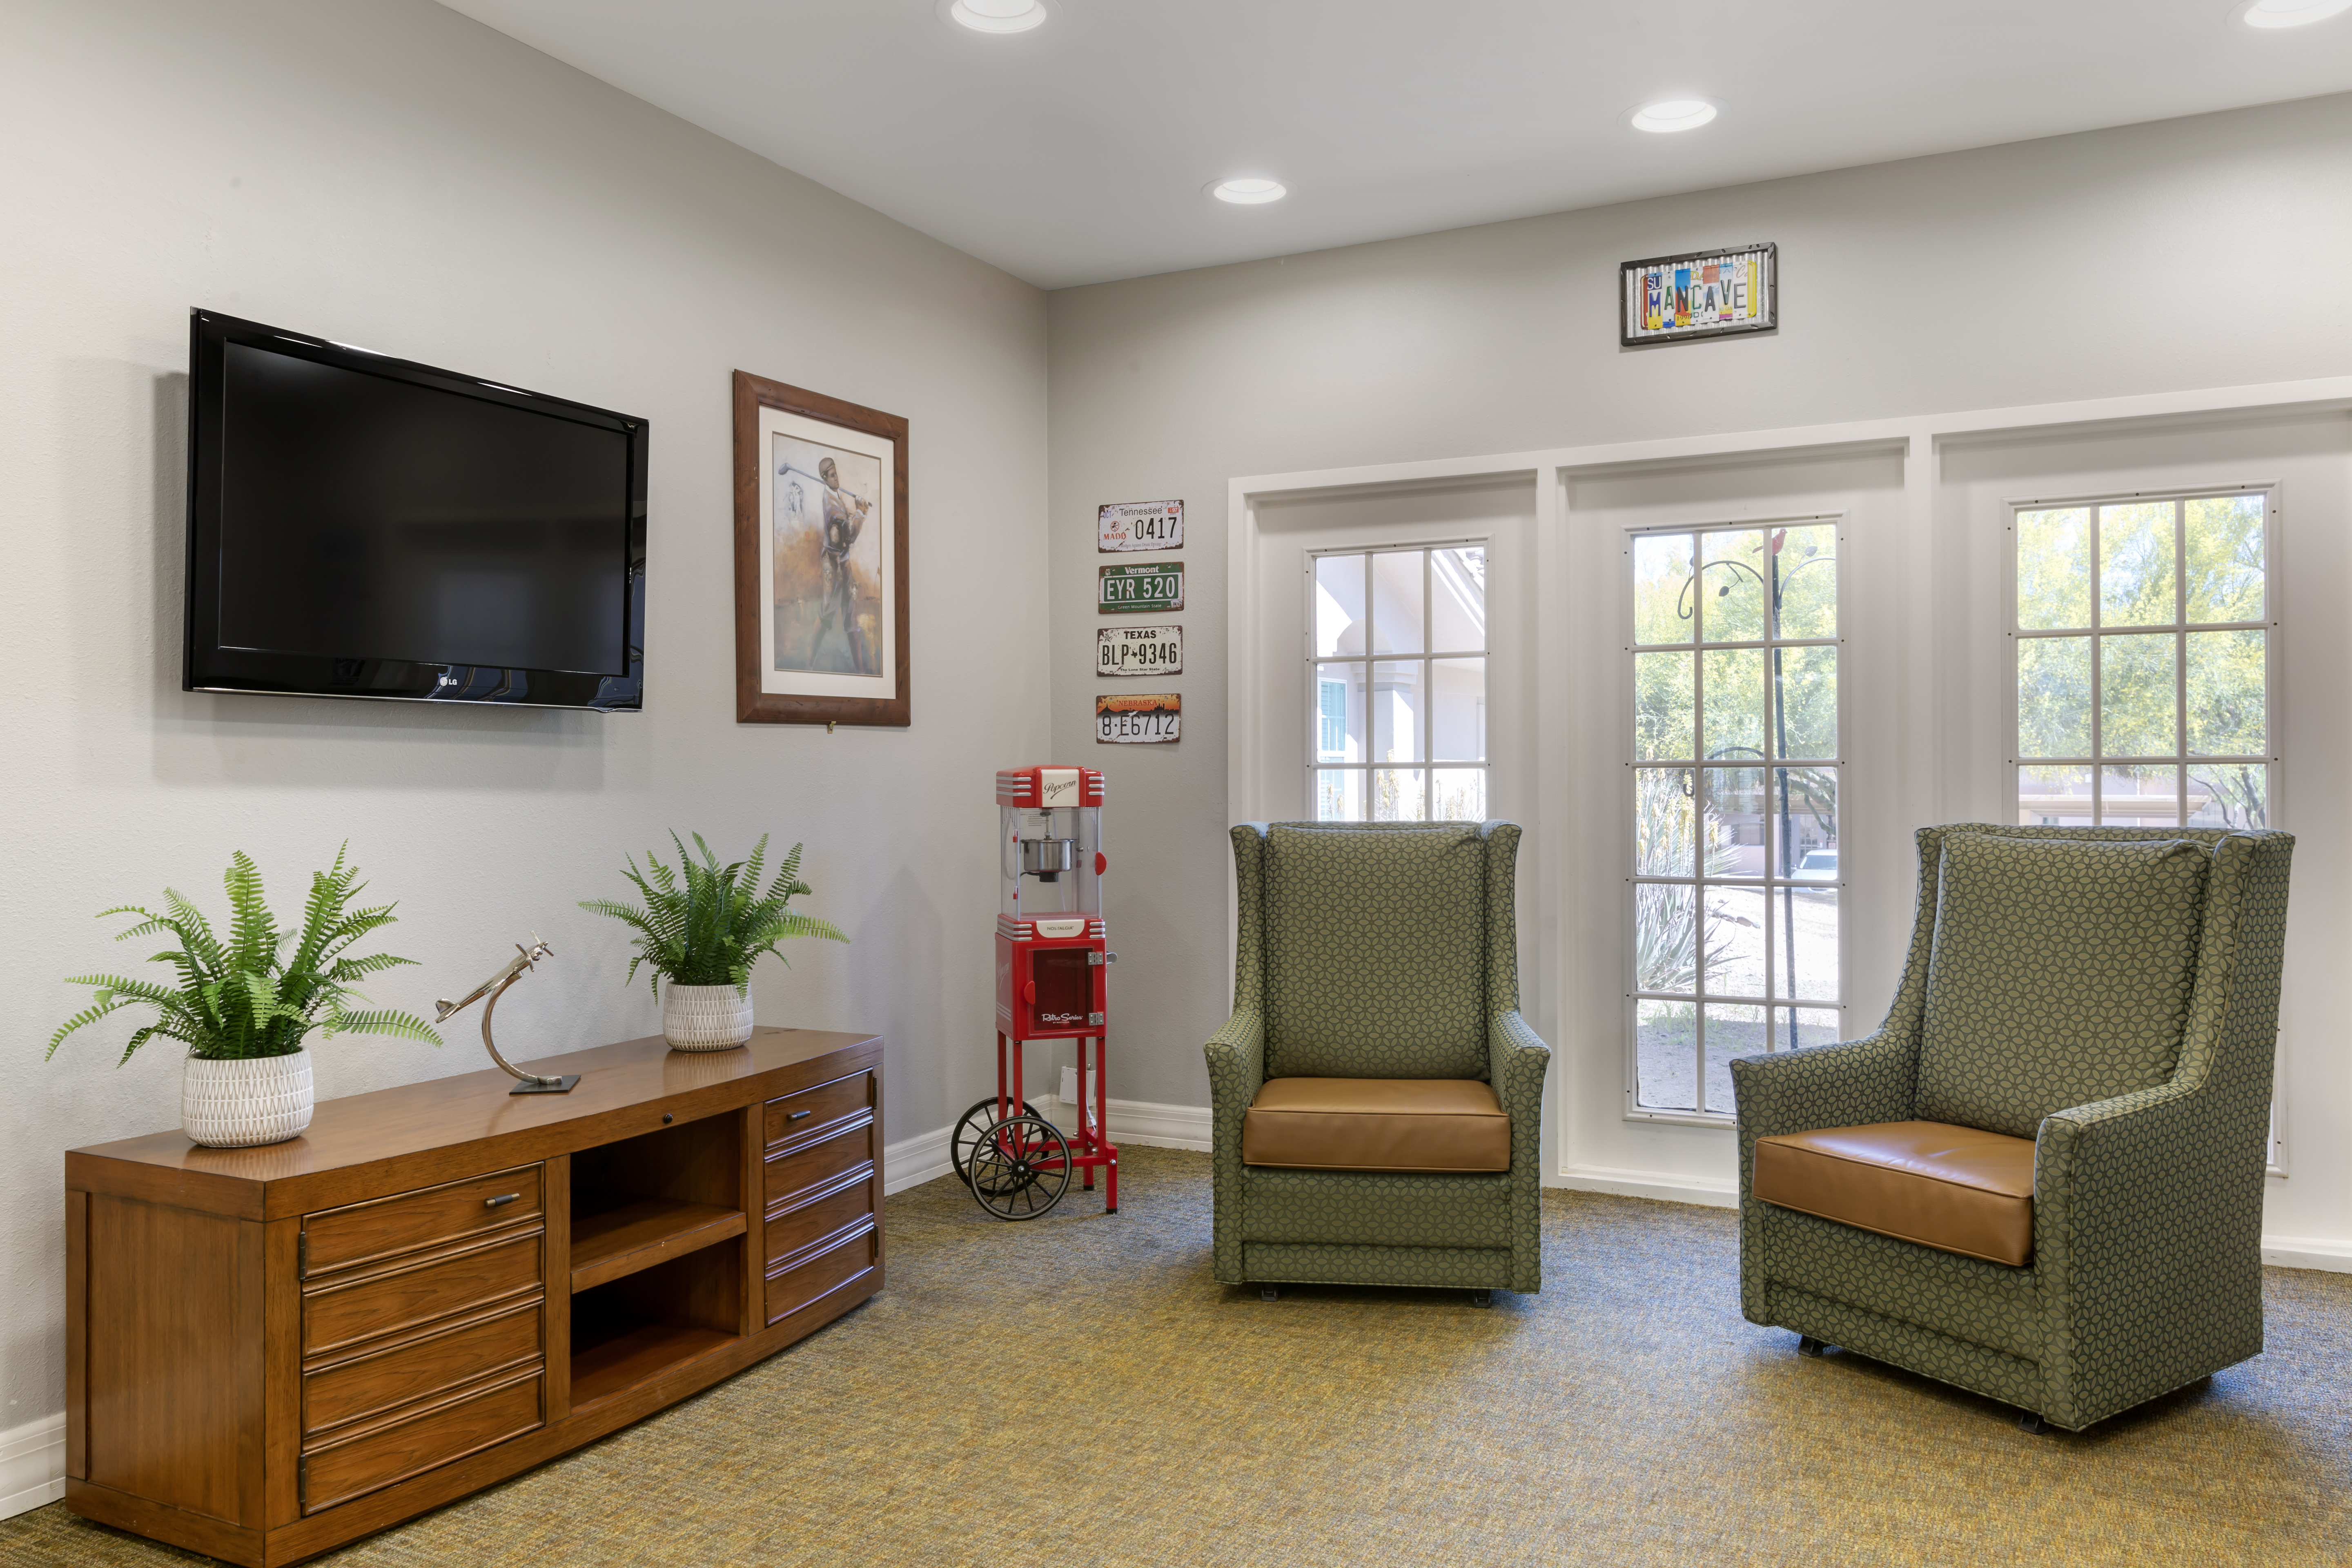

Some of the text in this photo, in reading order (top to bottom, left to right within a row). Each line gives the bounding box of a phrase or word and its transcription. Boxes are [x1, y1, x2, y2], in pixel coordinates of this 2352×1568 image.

[1647, 276, 1661, 290] SU
[1119, 508, 1162, 516] Tennessee
[1136, 517, 1177, 539] 0417
[1125, 566, 1159, 574] Vermont
[1107, 577, 1175, 599] EYR 520
[1124, 630, 1156, 639] TEXAS
[1102, 643, 1177, 665] BLP 9346
[1043, 780, 1077, 794] Popcorn
[1061, 1013, 1082, 1021] Series
